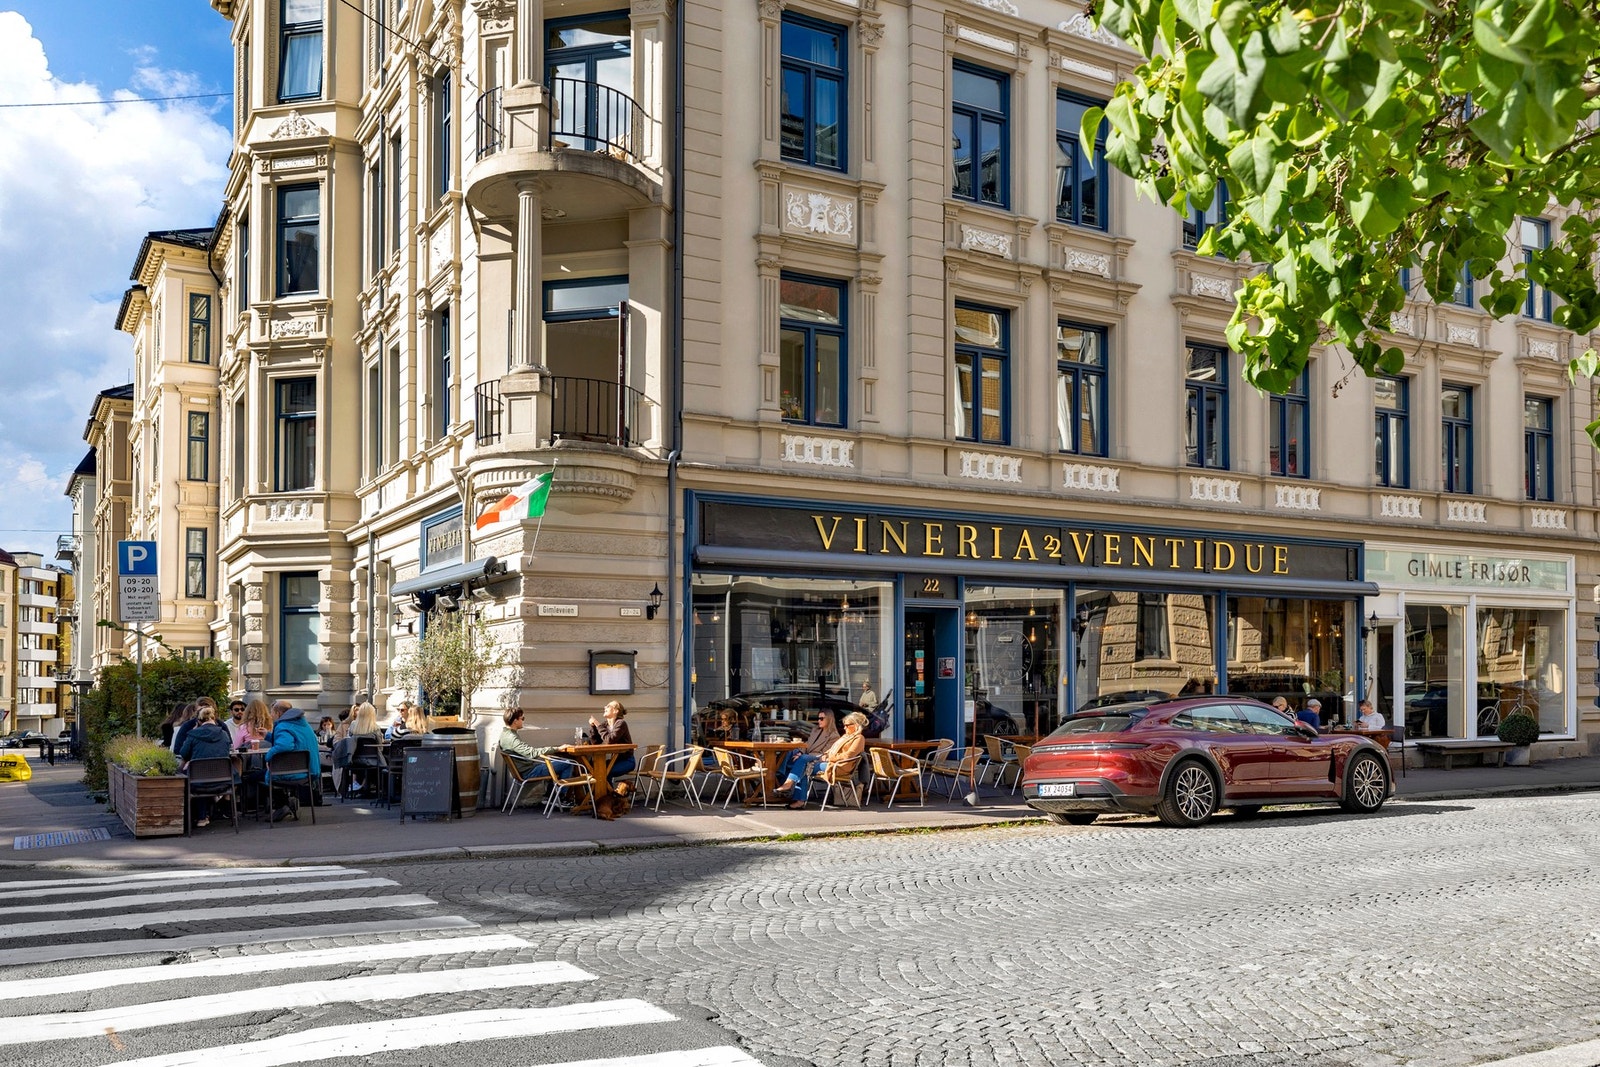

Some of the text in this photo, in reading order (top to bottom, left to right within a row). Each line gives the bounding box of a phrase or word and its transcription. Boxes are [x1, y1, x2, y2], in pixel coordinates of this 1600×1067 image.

[811, 515, 1039, 561] VINERIA
[1069, 532, 1290, 574] VENTIDUE
[127, 545, 148, 572] P
[1407, 559, 1531, 583] GIMLE FRISØR
[923, 578, 940, 592] 22
[542, 606, 575, 614] Gimleveien
